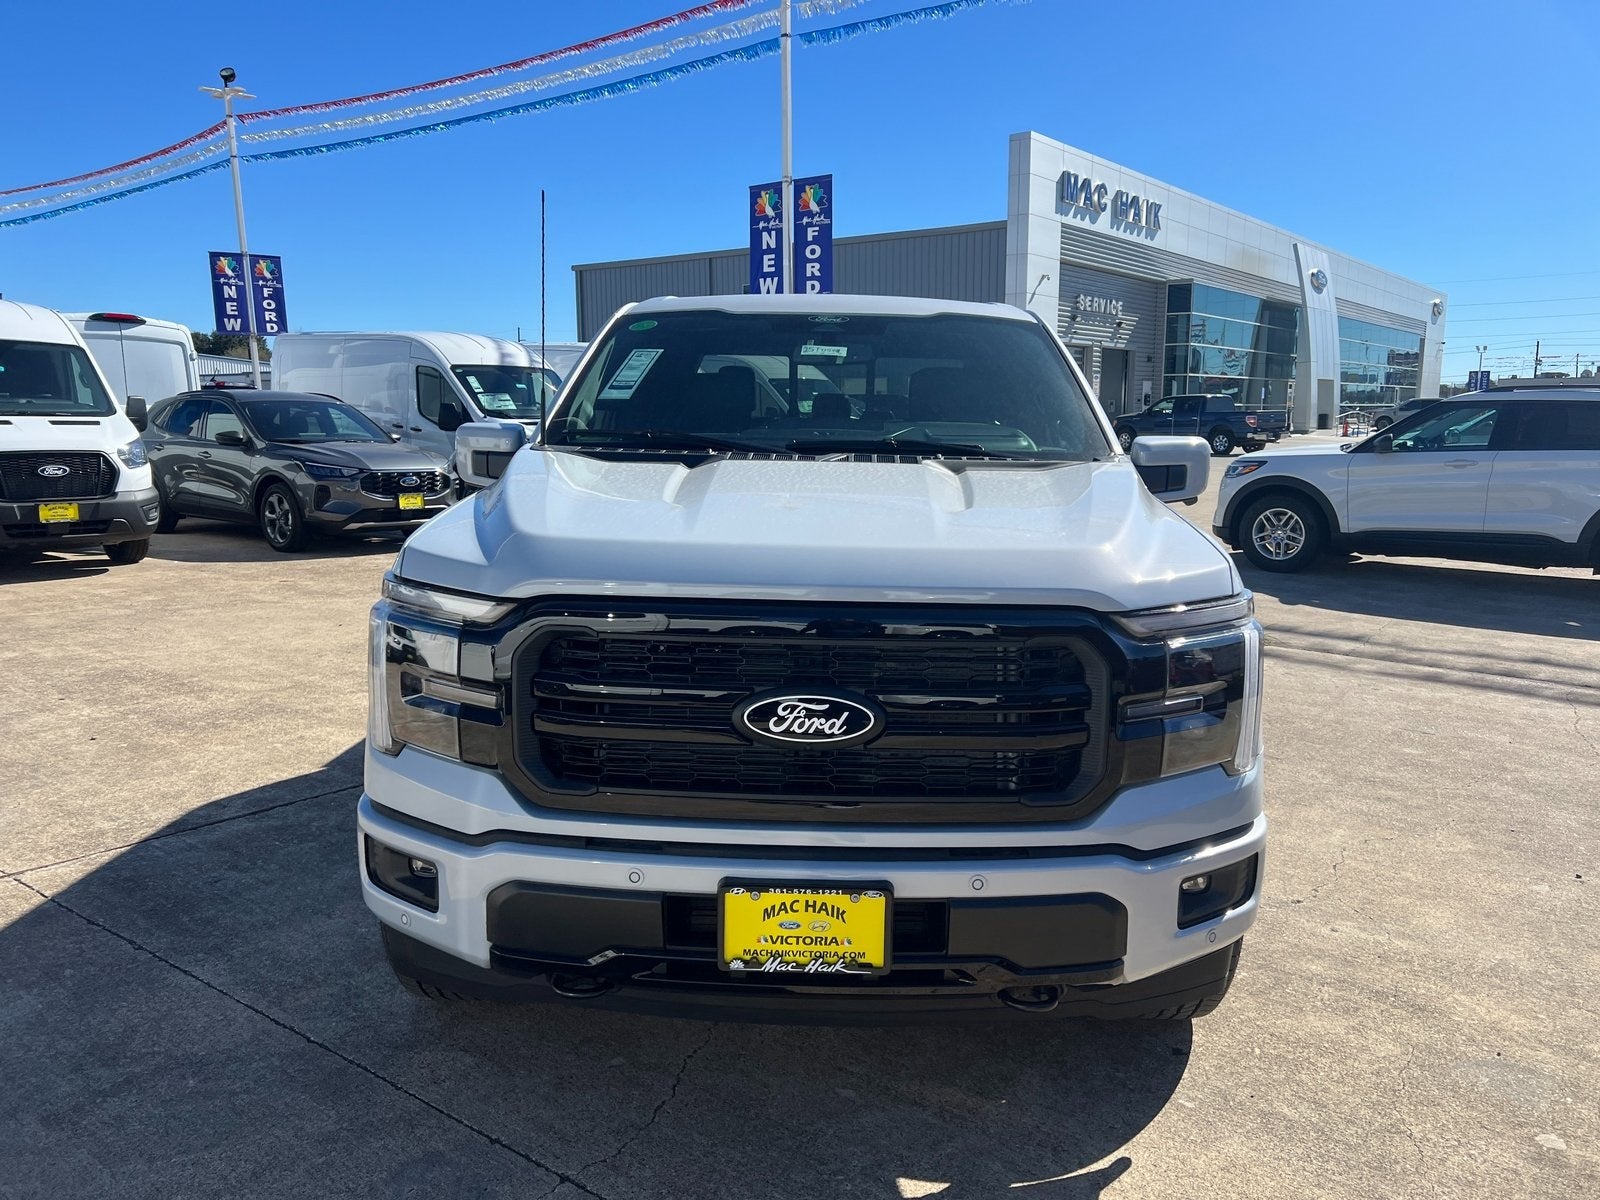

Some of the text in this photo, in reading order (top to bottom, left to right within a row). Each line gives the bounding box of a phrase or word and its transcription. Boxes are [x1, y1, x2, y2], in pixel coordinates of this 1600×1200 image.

[1060, 170, 1162, 231] MAC HAIK
[759, 230, 779, 294] NEW
[805, 226, 822, 294] FORD
[223, 285, 242, 331] NEW
[262, 287, 279, 333] FORD
[1077, 294, 1124, 316] SERVICE
[43, 467, 64, 475] Ford
[768, 701, 850, 735] Ford
[762, 899, 847, 924] MAC HAIK
[768, 935, 840, 946] VICTORIA
[760, 956, 850, 974] Mac Haik
